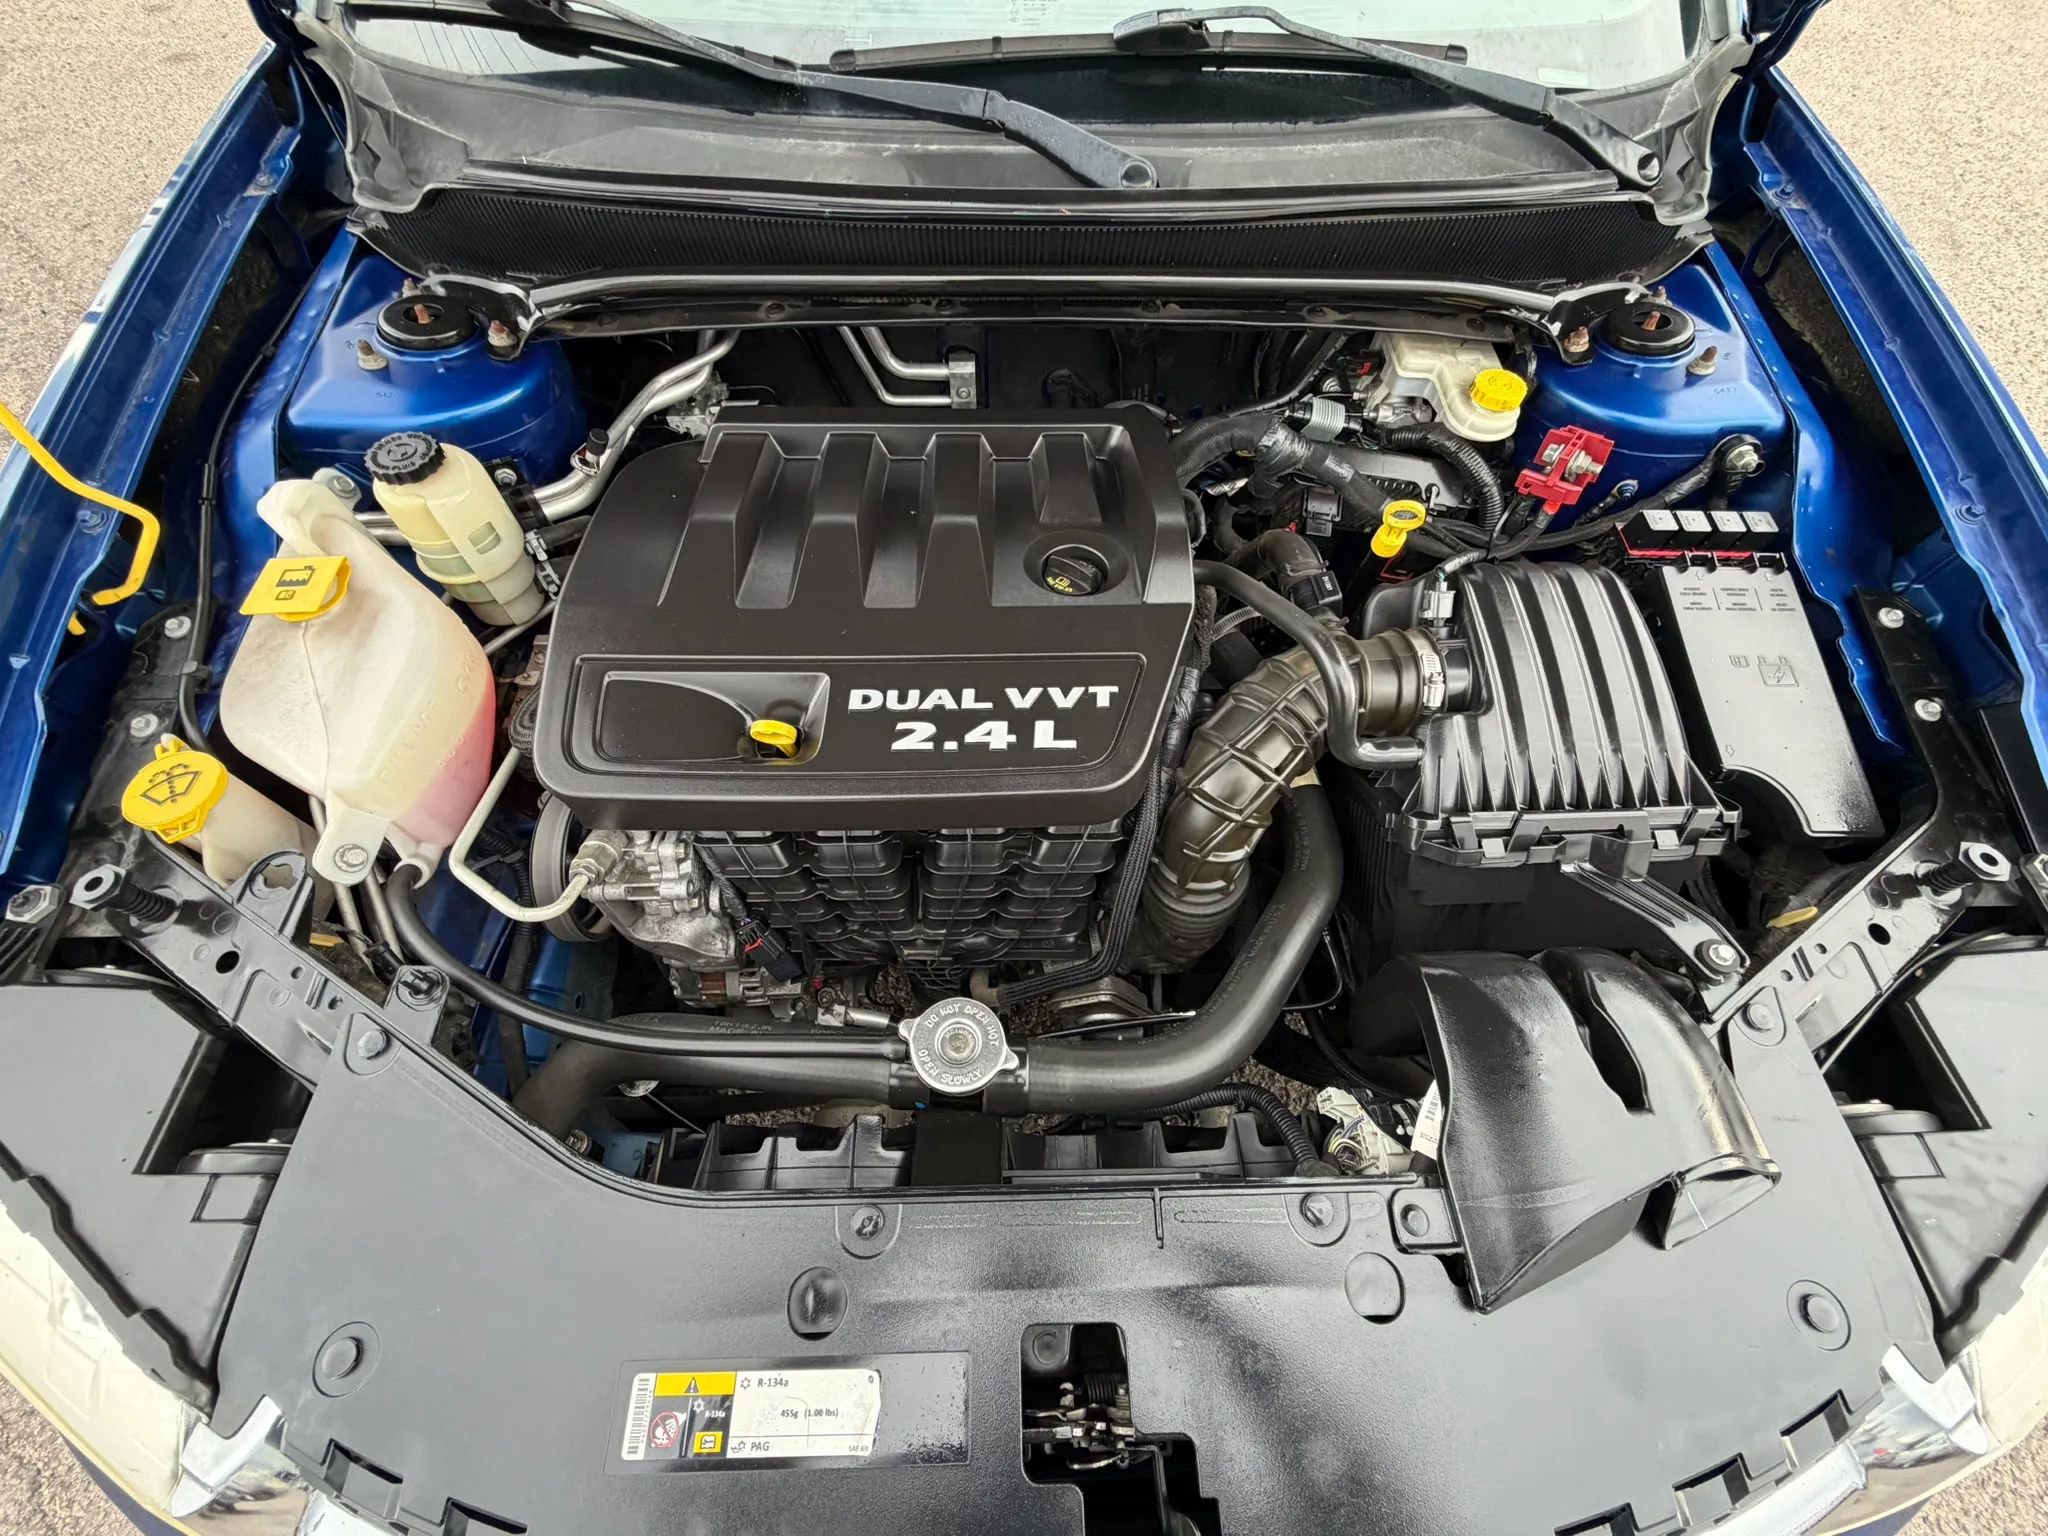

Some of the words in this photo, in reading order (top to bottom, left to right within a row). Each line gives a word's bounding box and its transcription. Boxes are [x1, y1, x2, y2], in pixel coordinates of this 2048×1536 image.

[848, 687, 994, 711] DUAL
[1004, 685, 1119, 710] VVT
[924, 1013, 939, 1028] DO
[939, 1003, 961, 1016] NOT
[964, 1005, 988, 1024] OPEN
[986, 1025, 1000, 1046] HOT
[918, 1049, 939, 1077] OPEN
[940, 1066, 983, 1085] SLOWLY
[757, 1377, 789, 1388] R-134a
[704, 1410, 726, 1418] R-134a
[780, 1409, 799, 1419] 455g
[804, 1408, 824, 1419] (1.00
[825, 1407, 839, 1419] lbs)
[750, 1441, 770, 1452] PAG
